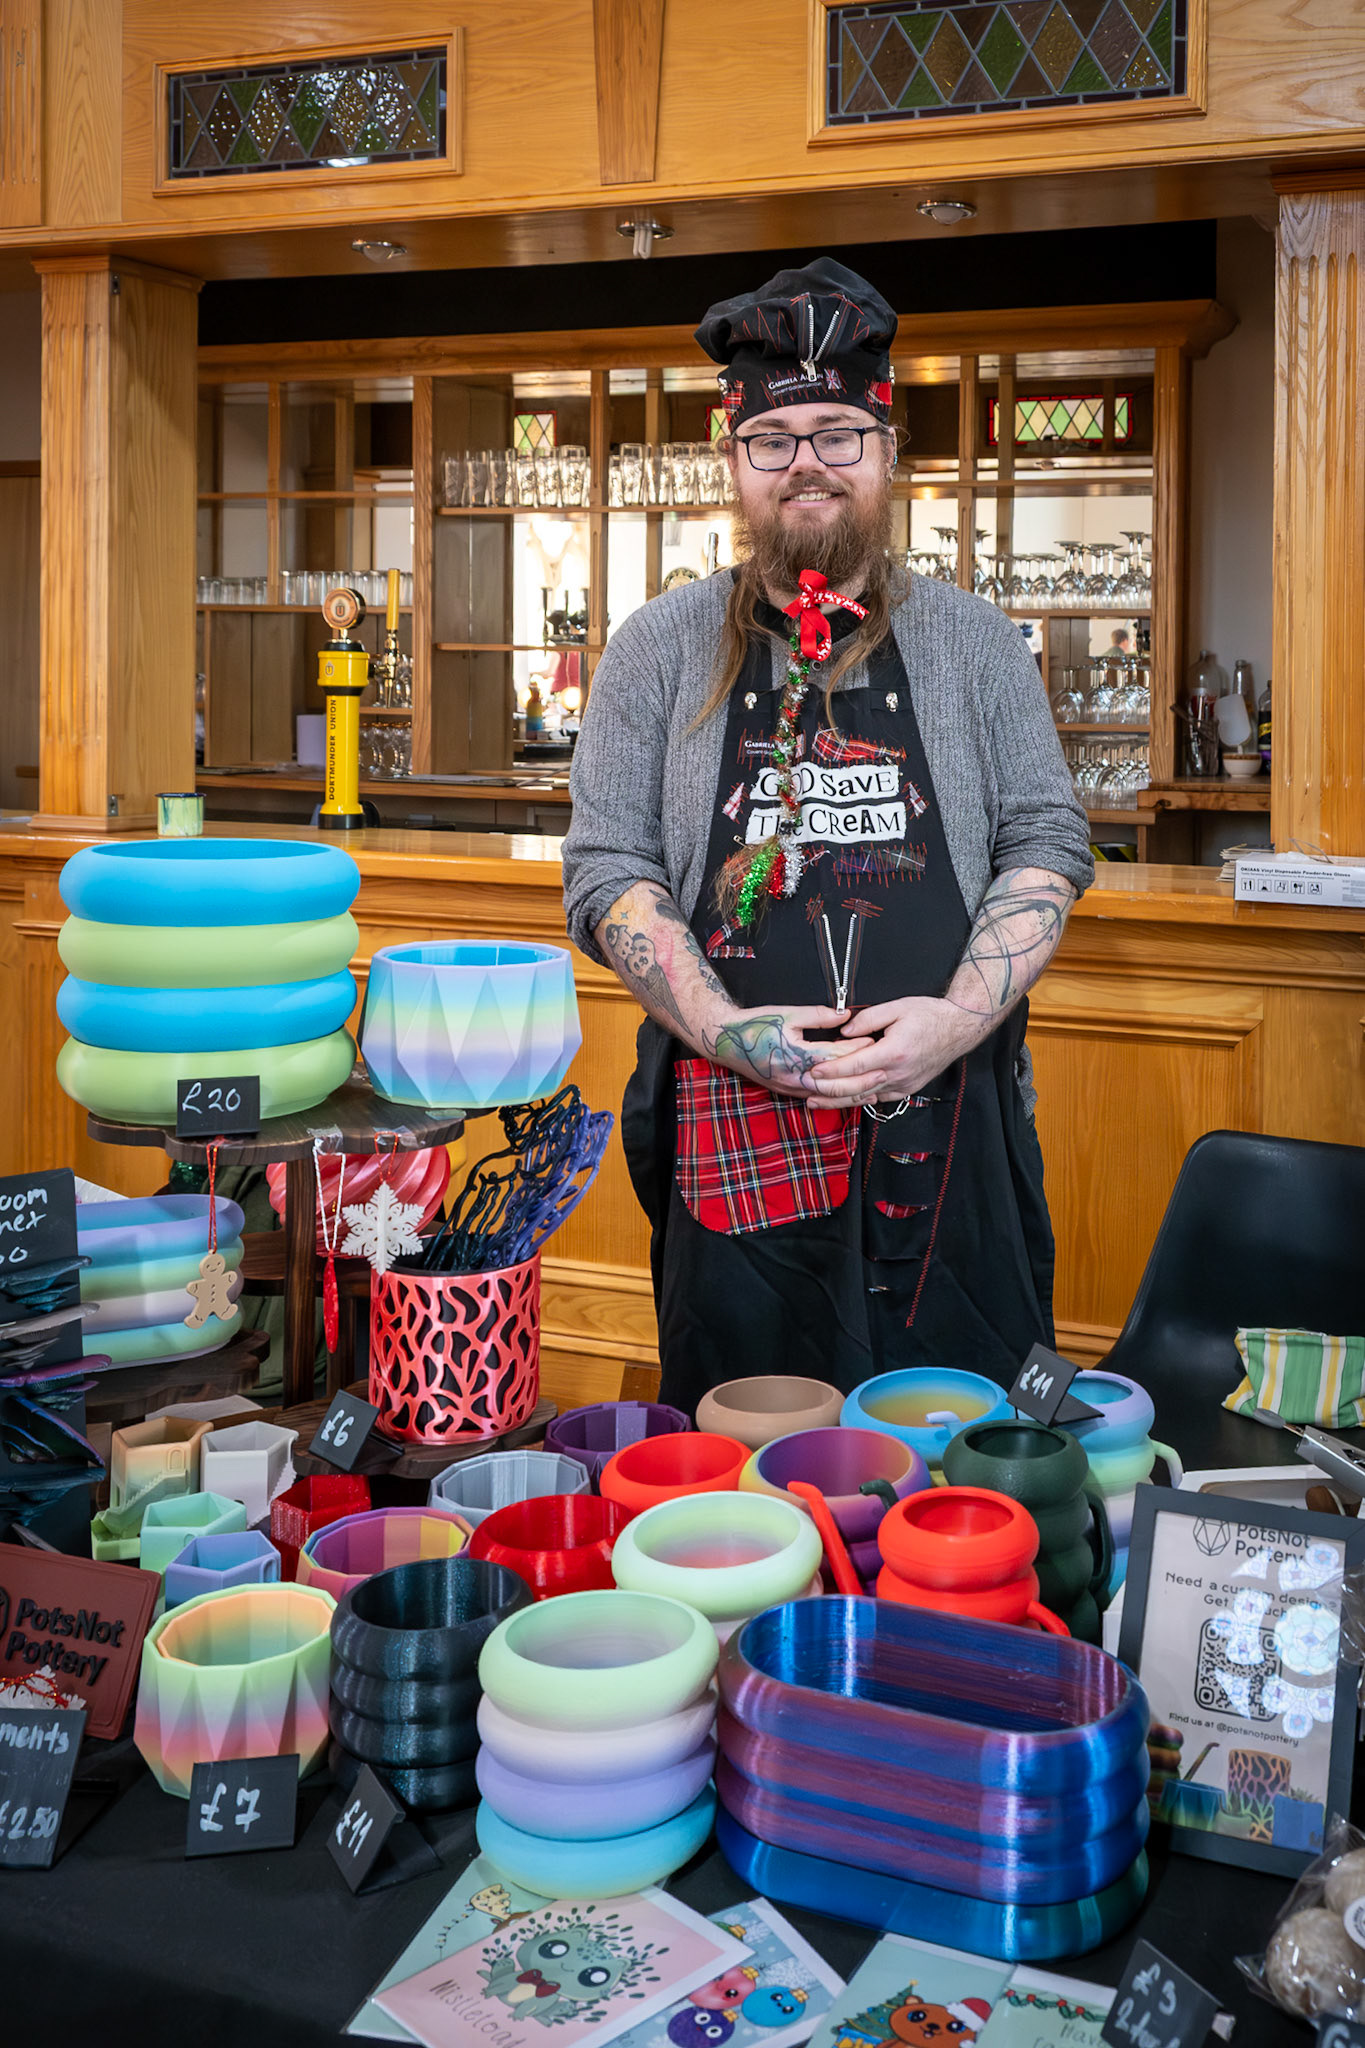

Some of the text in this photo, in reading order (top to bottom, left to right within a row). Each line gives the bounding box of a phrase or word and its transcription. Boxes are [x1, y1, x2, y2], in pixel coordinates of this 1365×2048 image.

[1019, 1363, 1055, 1400] £11
[321, 1409, 355, 1447] £6
[1236, 1523, 1311, 1548] PotsNot
[1165, 1571, 1203, 1588] Need
[1209, 1581, 1218, 1591] a
[1221, 1584, 1275, 1601] cum
[1204, 1594, 1229, 1607] Get
[15, 1598, 125, 1648] PotsNot
[5, 1630, 110, 1687] Pottery
[1168, 1712, 1189, 1723] Find
[1191, 1718, 1203, 1727] us
[1216, 1722, 1299, 1748] @potsnotpottery
[200, 1782, 261, 1833] £7
[335, 1799, 374, 1858] £11
